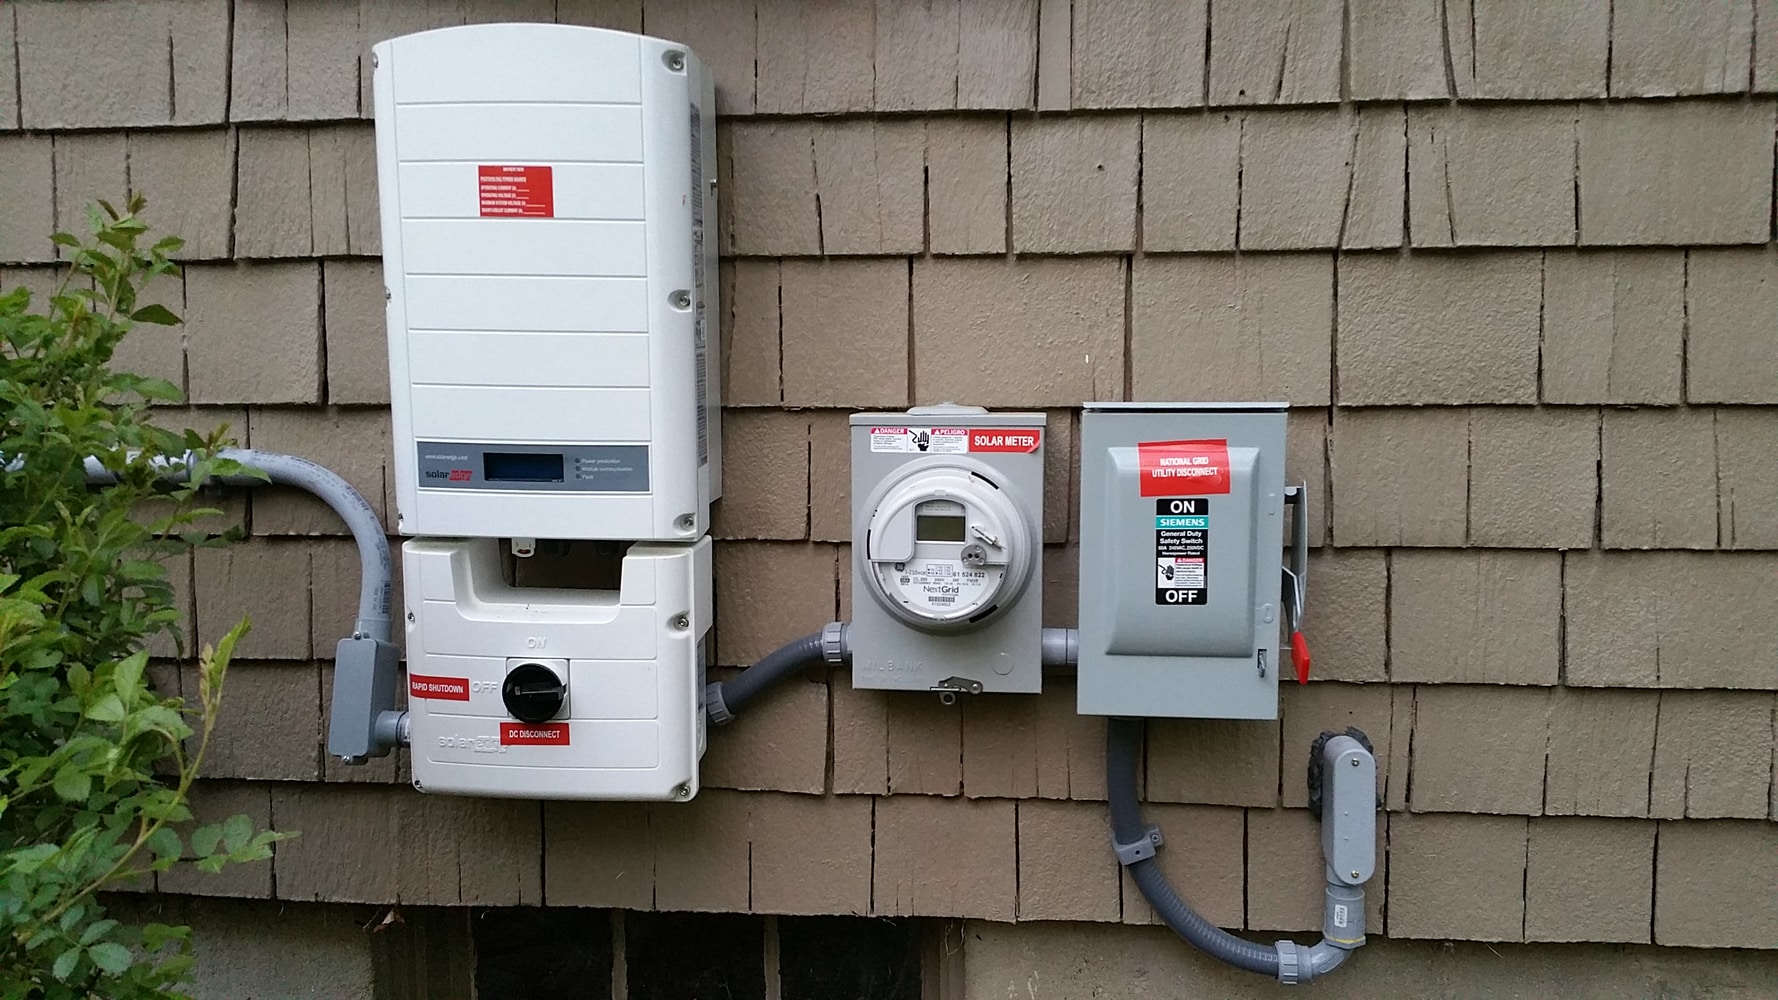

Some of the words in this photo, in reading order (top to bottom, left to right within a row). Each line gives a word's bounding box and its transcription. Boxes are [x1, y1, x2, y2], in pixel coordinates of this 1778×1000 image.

[974, 435, 1003, 446] SOLAR
[1005, 436, 1034, 446] METER
[1160, 457, 1192, 466] NATIONAL
[1192, 456, 1208, 465] GRID
[1152, 468, 1176, 478] UTILITY
[1176, 466, 1218, 477] DISCONNECT
[1170, 500, 1195, 513] ON
[1160, 518, 1205, 527] SIEMENS
[1187, 530, 1202, 538] Duty
[1159, 537, 1180, 545] Safety
[923, 585, 959, 593] NextGrid
[1165, 589, 1198, 603] OFF
[527, 636, 546, 649] ON
[411, 681, 427, 692] RAPID
[428, 683, 464, 694] SHUTDOWN
[472, 680, 499, 694] OFF
[508, 729, 518, 738] DC
[519, 729, 561, 739] DISCONNECT
